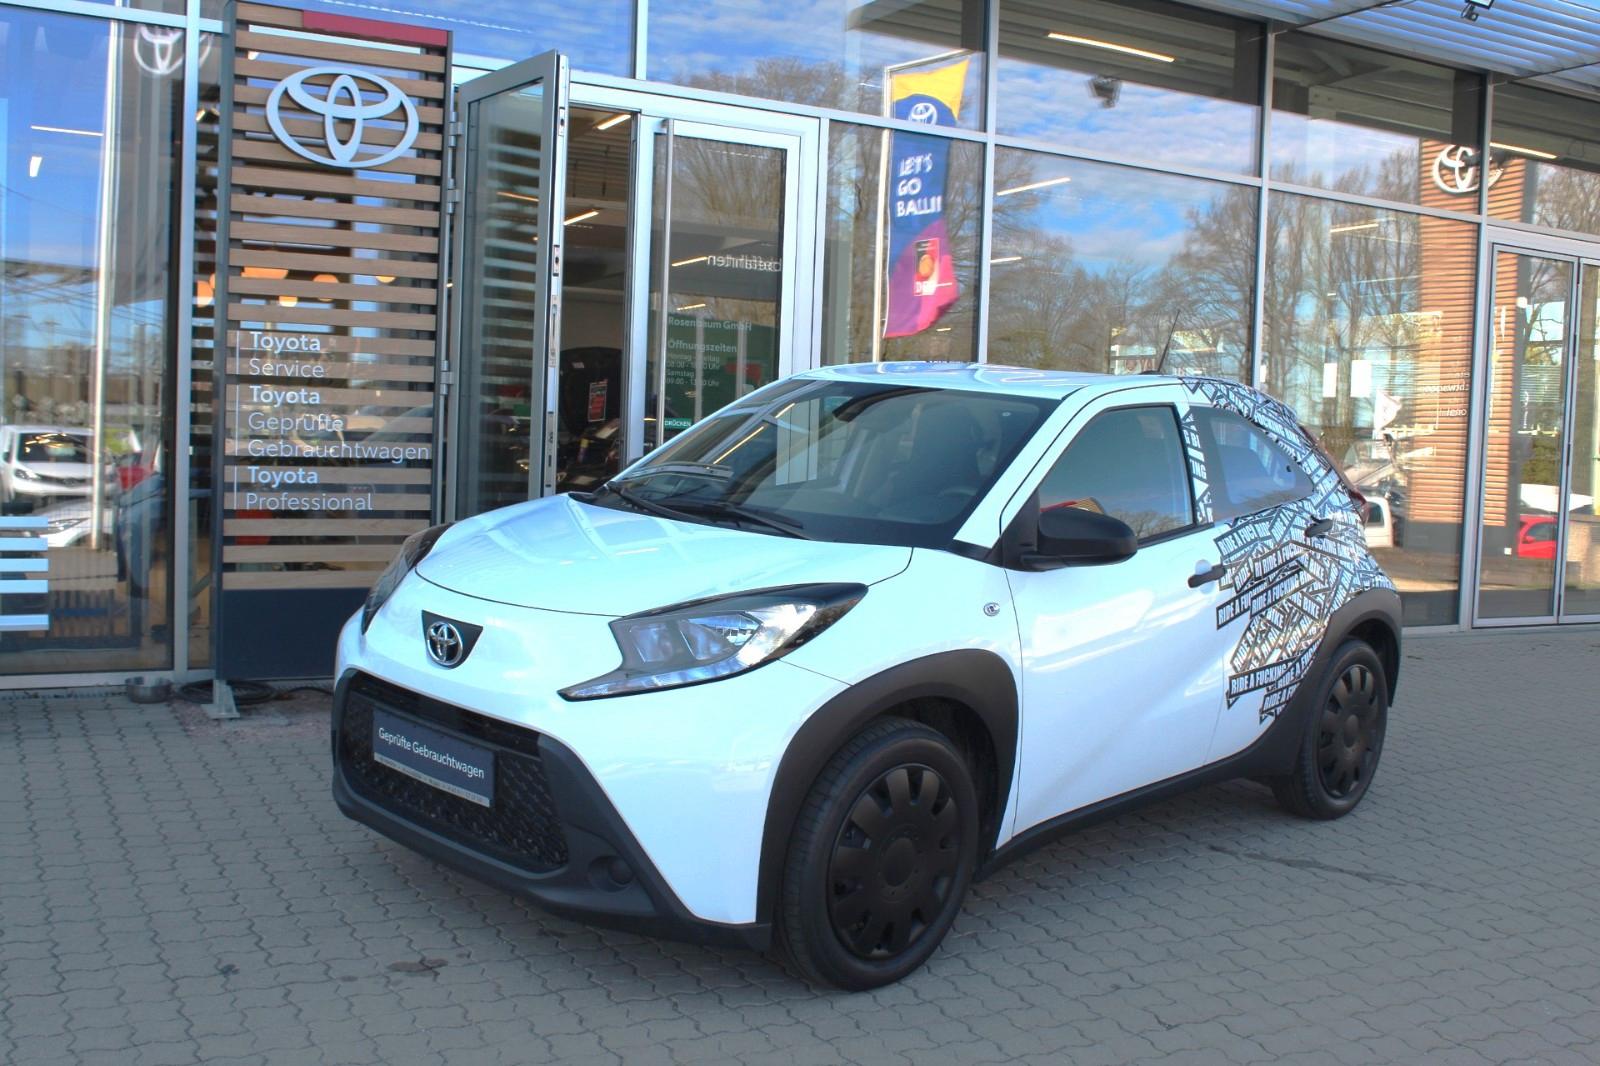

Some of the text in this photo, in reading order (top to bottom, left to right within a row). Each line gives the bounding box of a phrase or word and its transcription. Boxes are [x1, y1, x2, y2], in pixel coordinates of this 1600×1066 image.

[898, 153, 933, 177] LET'S
[897, 177, 921, 196] GO
[250, 331, 321, 353] Toyota
[249, 358, 324, 378] Service
[250, 385, 321, 407] Toyota
[248, 440, 430, 463] Gebrauchtwagen
[247, 466, 318, 487] Toyota
[246, 493, 373, 511] Professional
[1231, 673, 1250, 695] RIDE
[1248, 670, 1256, 689] A
[1255, 661, 1285, 687] FUCKING
[378, 727, 485, 779] Geprüfte Gebrauchtwagen
